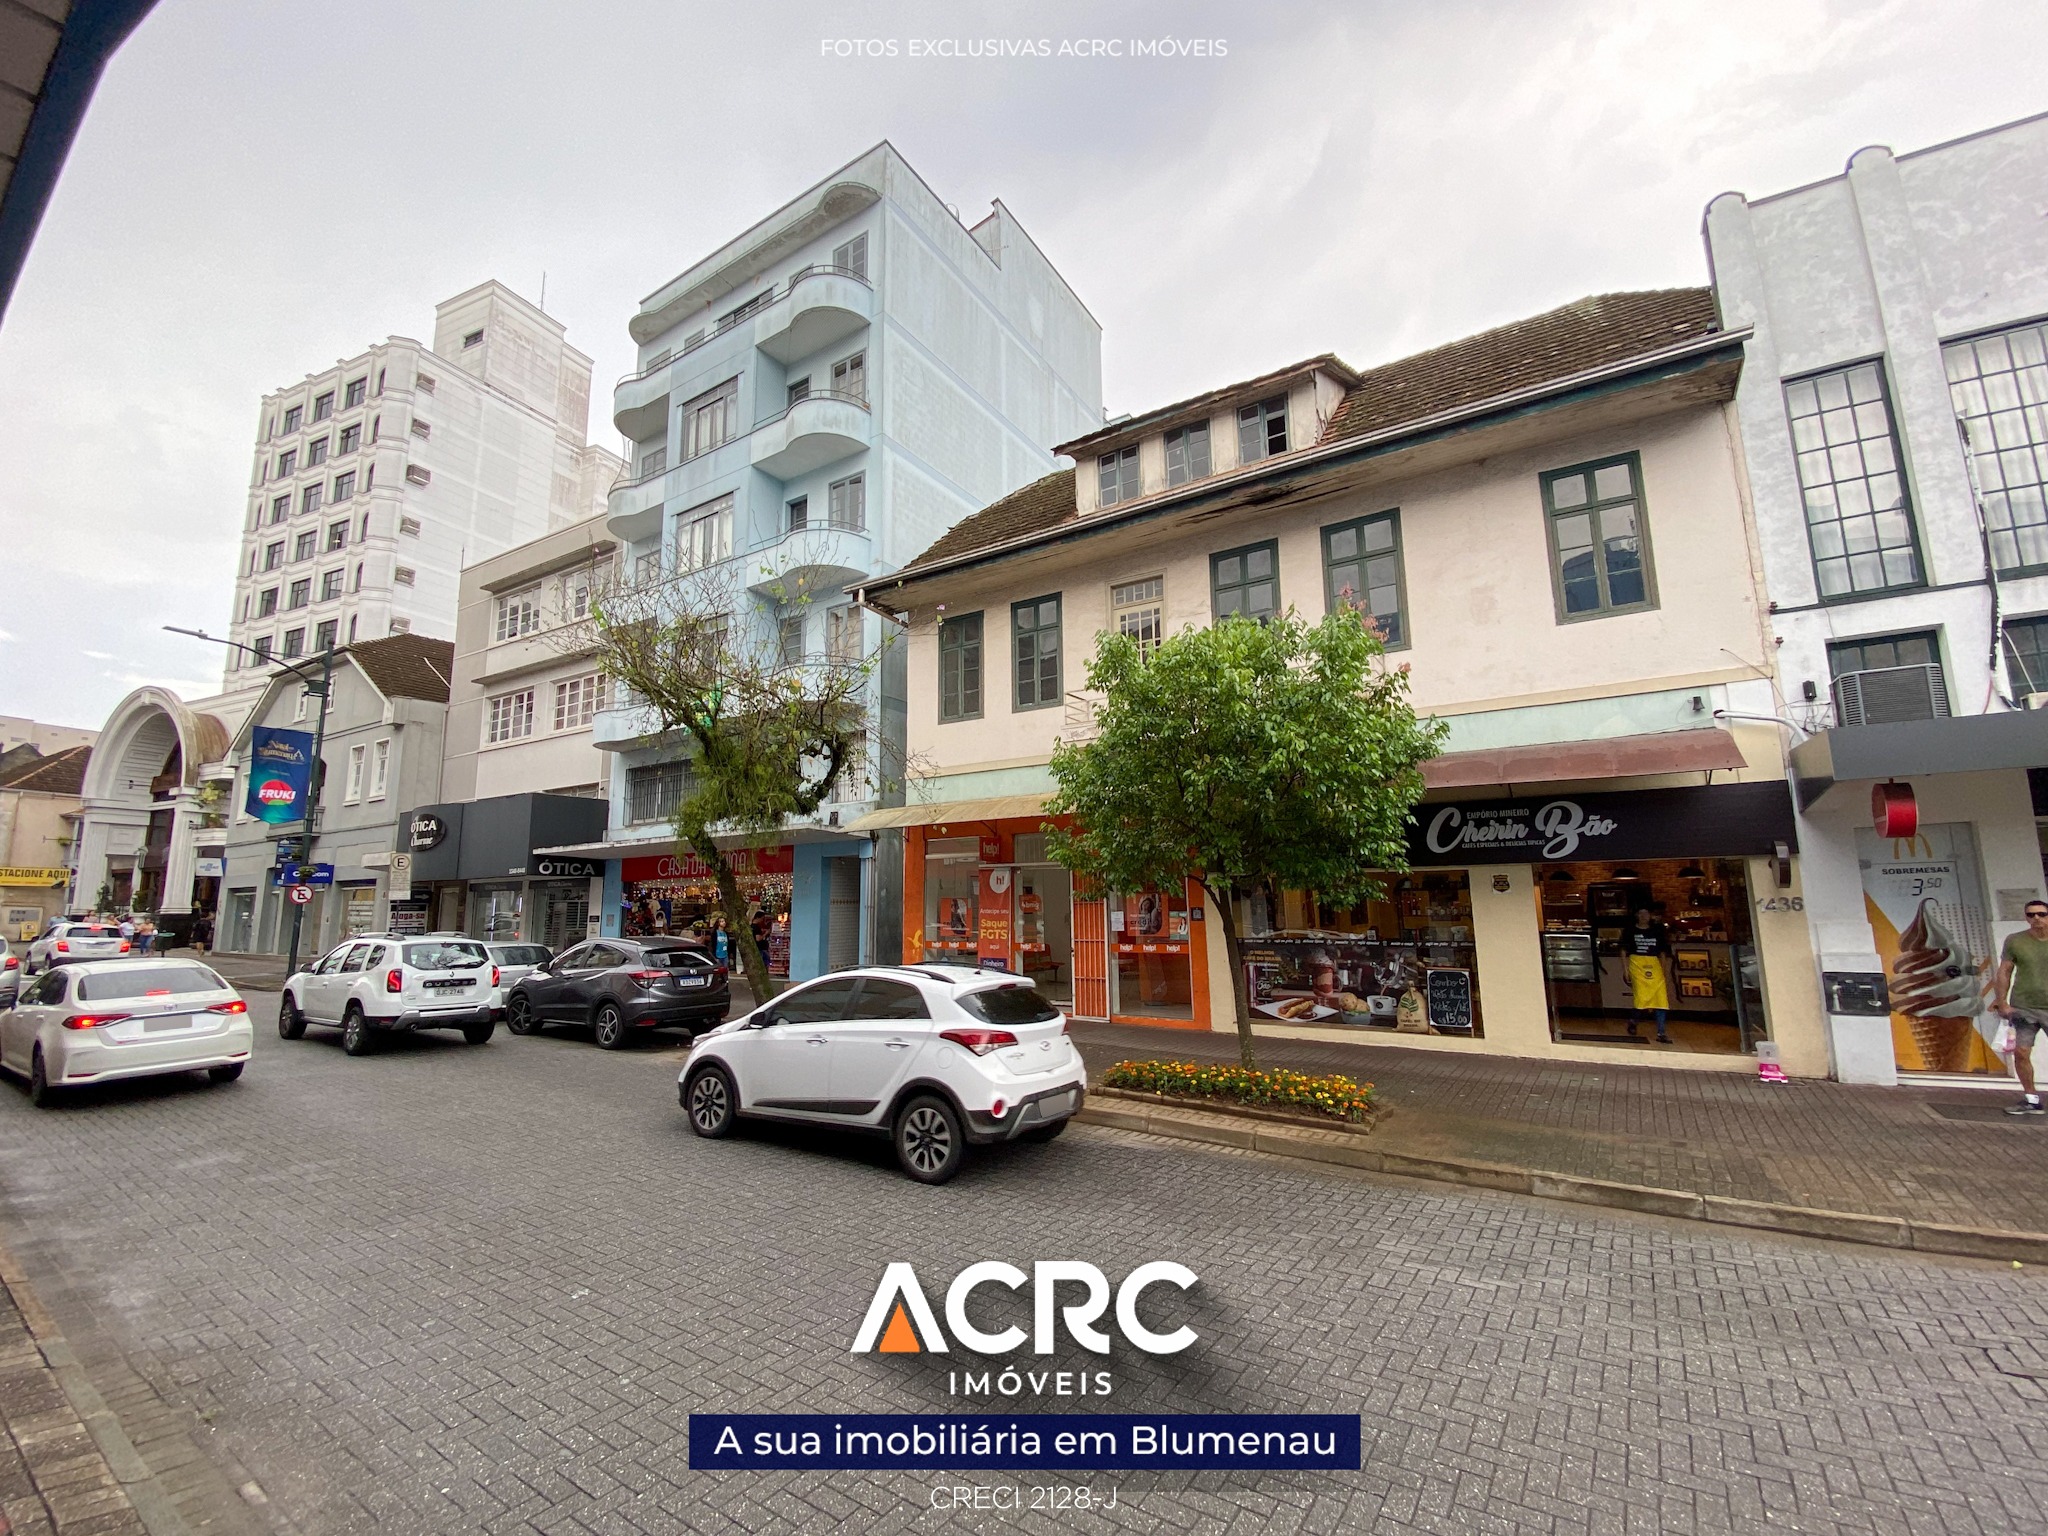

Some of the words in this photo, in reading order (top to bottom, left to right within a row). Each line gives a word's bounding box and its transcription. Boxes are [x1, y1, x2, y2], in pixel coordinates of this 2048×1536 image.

[258, 789, 297, 800] FRUKI
[1466, 809, 1498, 820] EMPÓRIO
[1499, 808, 1530, 818] MINEIRO
[1426, 806, 1529, 853] Cheirin
[1534, 801, 1618, 859] Bão
[982, 842, 1000, 855] help!
[538, 859, 595, 875] ÓTICA
[691, 856, 707, 875] DA
[1881, 866, 1950, 875] SOBREMESAS
[980, 918, 1008, 929] Saque
[980, 929, 1009, 940] FGTS
